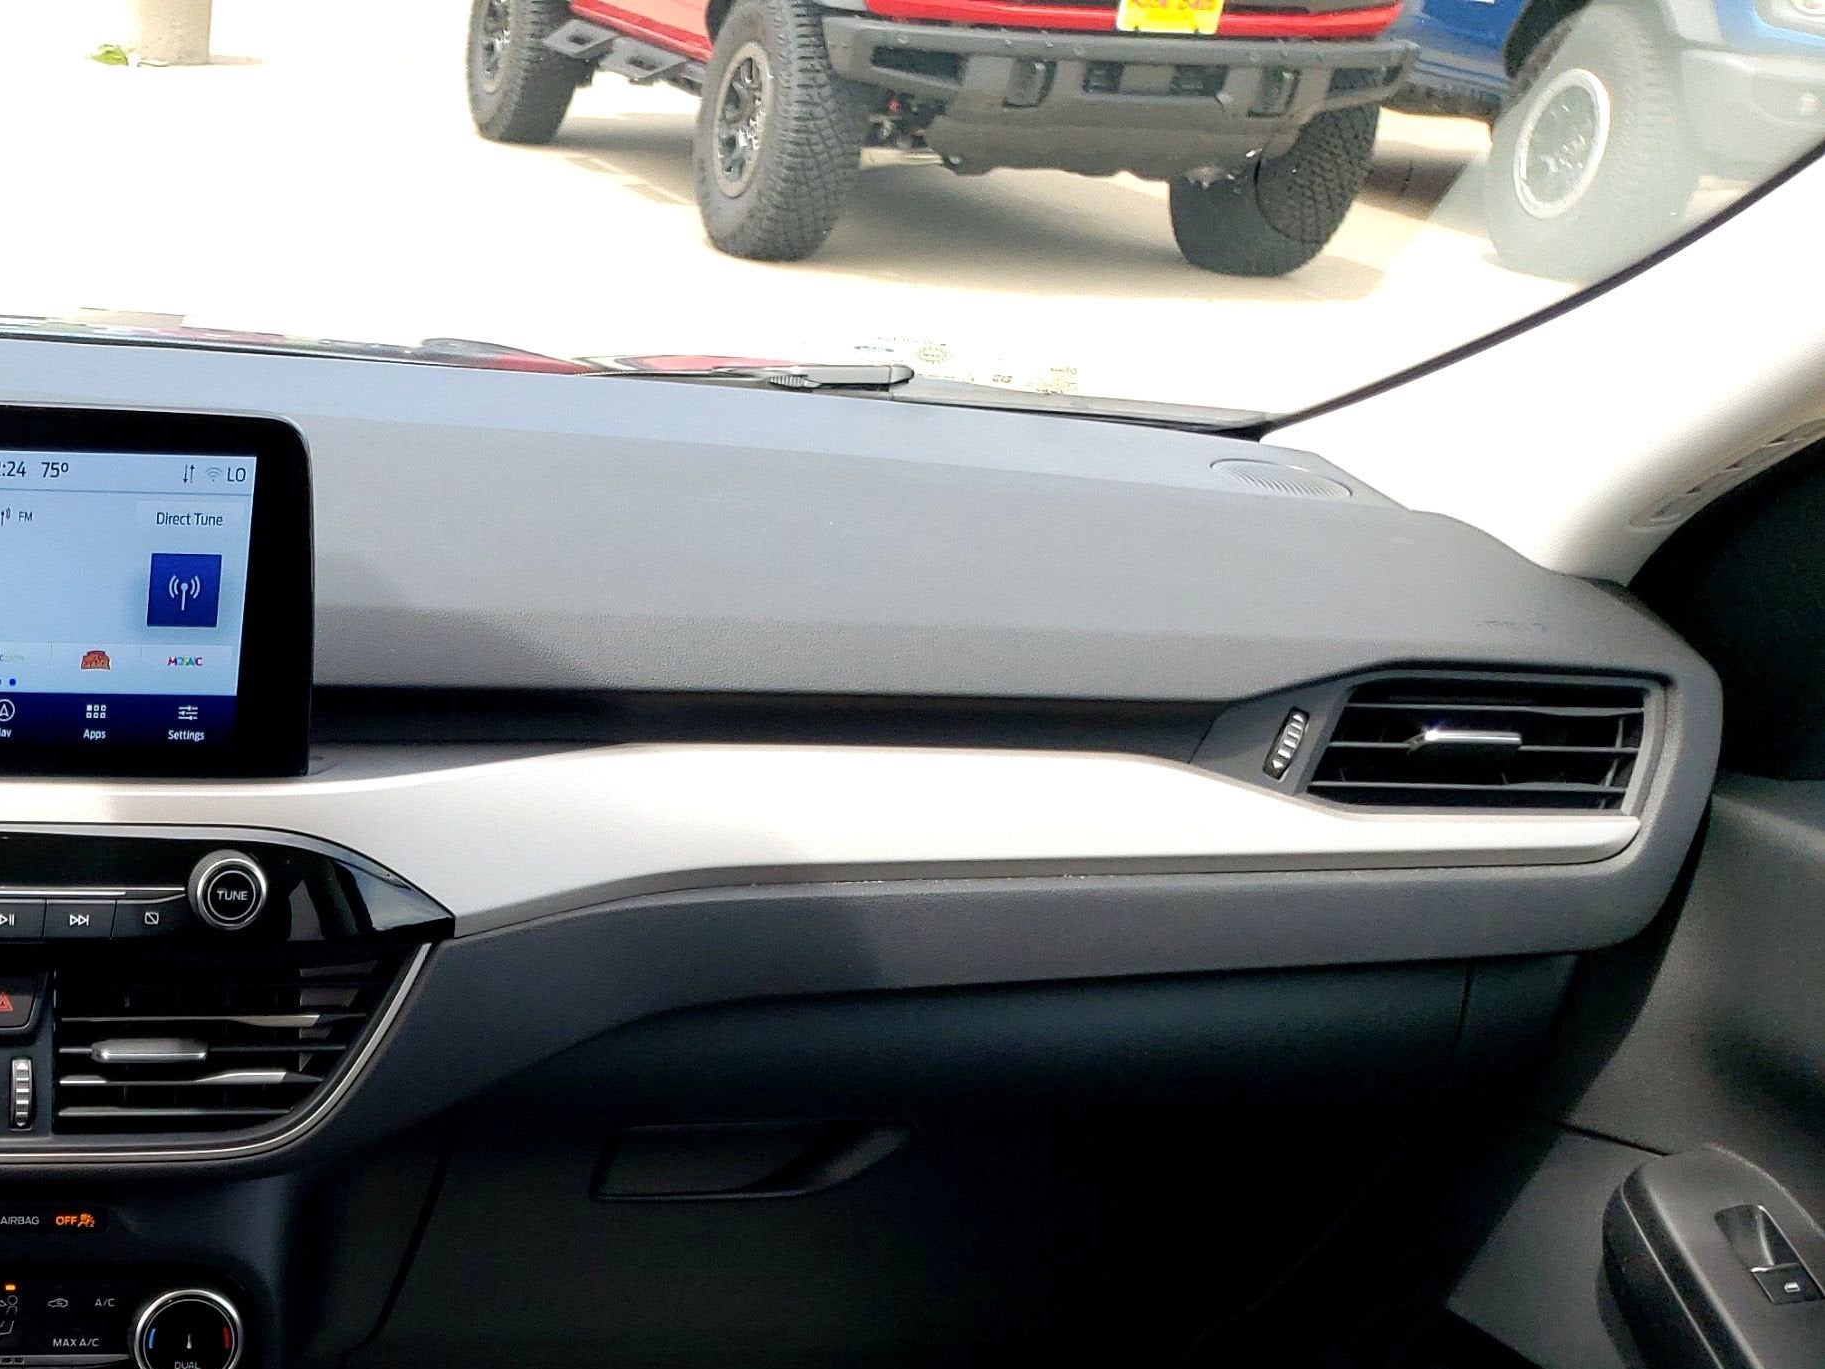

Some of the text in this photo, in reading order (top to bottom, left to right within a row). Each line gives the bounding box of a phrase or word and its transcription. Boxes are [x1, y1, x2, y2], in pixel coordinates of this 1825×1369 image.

[227, 467, 247, 482] LO
[18, 511, 33, 522] FM
[155, 512, 223, 526] Direct Tune
[83, 728, 106, 740] Apps
[168, 729, 205, 741] Settings
[216, 890, 249, 901] TUNE
[0, 1215, 40, 1226] AIRBAG
[55, 1215, 78, 1226] OFF
[94, 1297, 116, 1308] A/C
[52, 1338, 100, 1348] MAX A/C
[174, 1361, 202, 1369] DUAL
